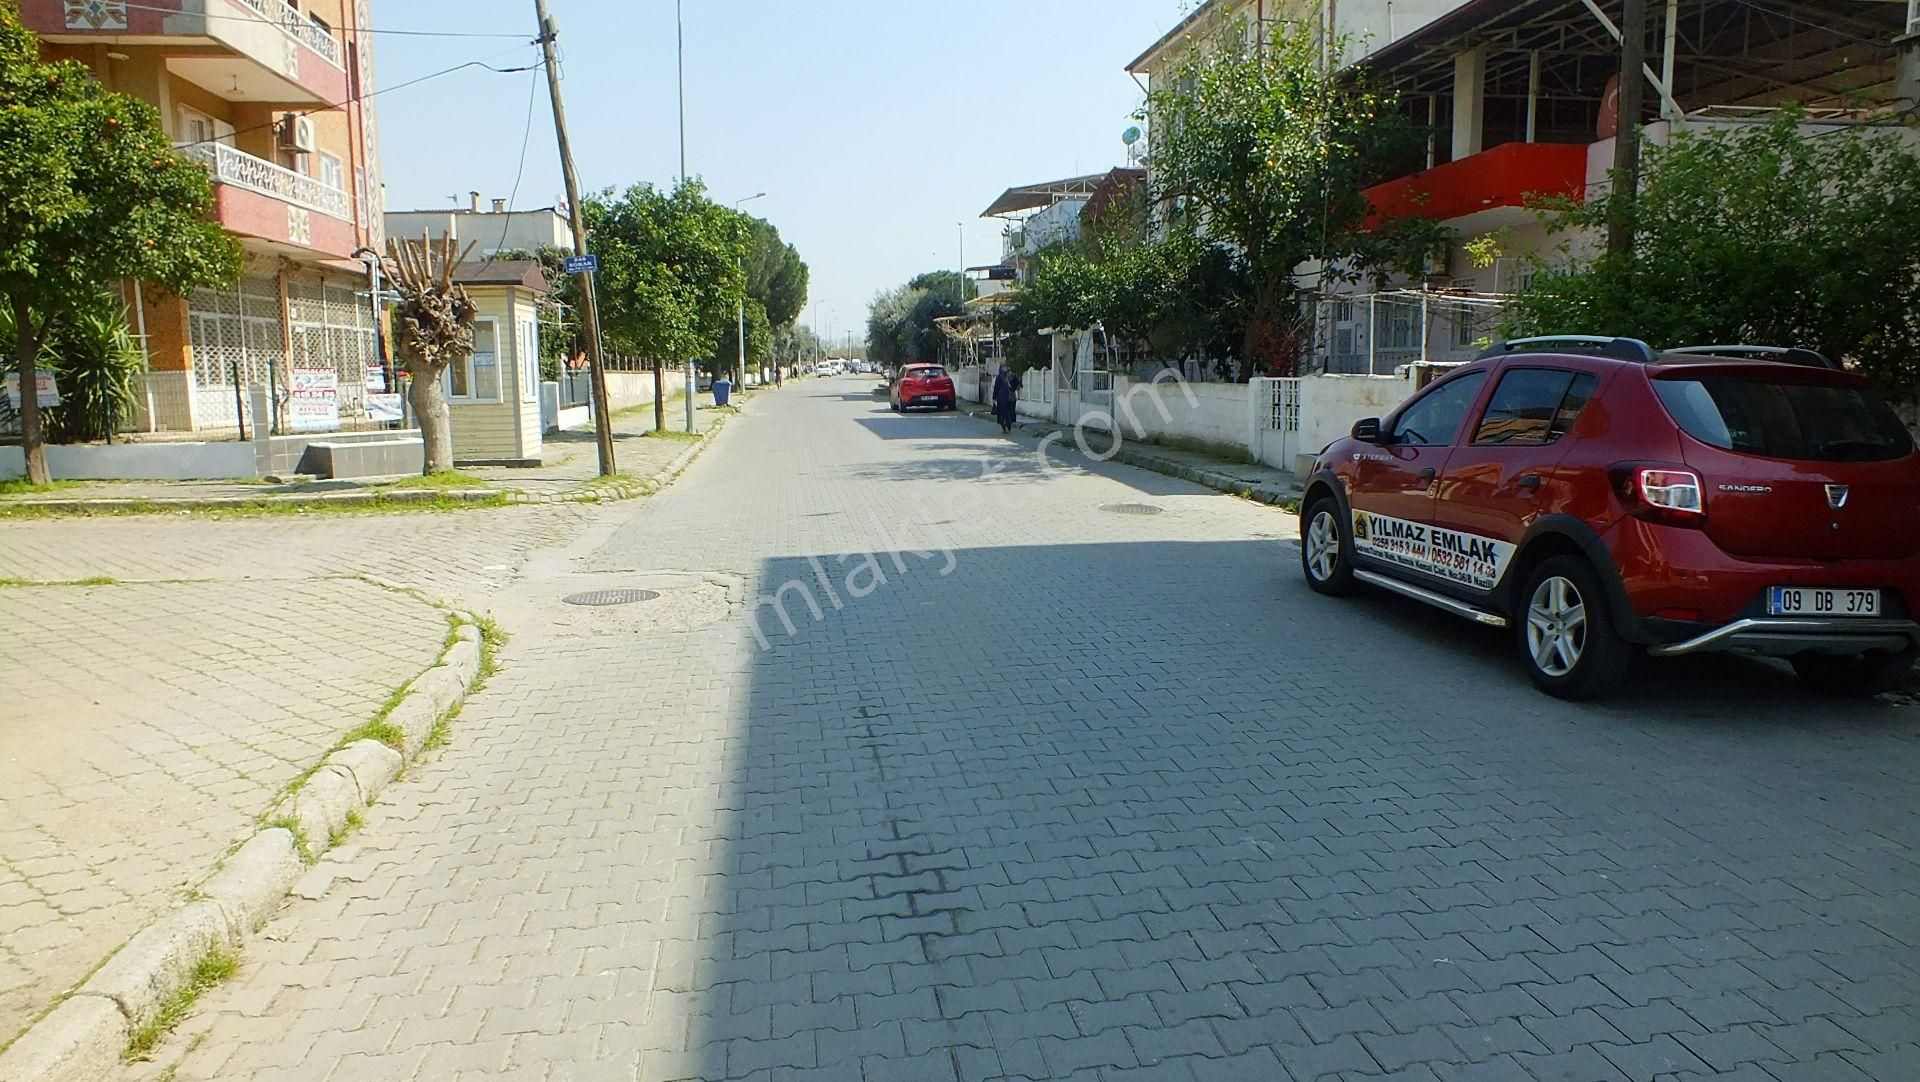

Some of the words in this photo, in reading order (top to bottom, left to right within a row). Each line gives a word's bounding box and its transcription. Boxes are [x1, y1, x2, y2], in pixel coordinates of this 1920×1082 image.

[1718, 484, 1773, 493] SANDERO
[1368, 515, 1426, 542] YILMAZ
[1431, 530, 1497, 565] EMLAK
[1411, 542, 1426, 558] 444
[1431, 548, 1452, 566] 0532
[1453, 555, 1470, 571] 581
[1783, 590, 1802, 611] 09
[1815, 591, 1833, 611] DB
[1846, 592, 1874, 612] 379
